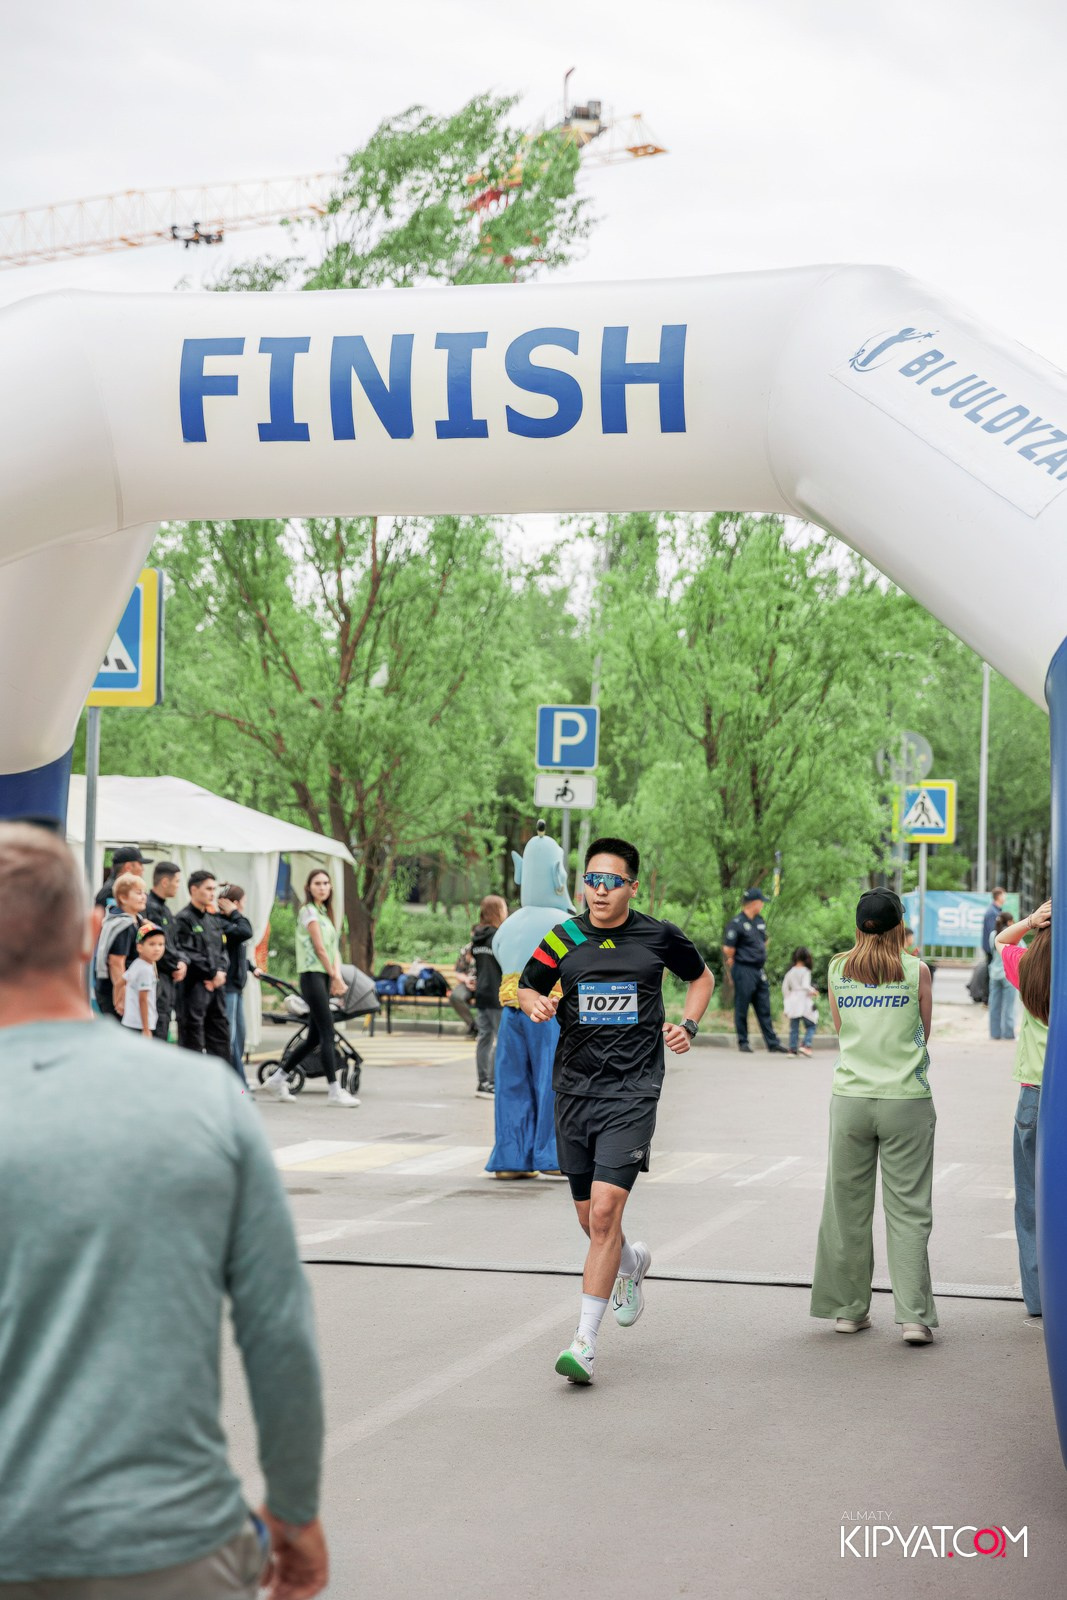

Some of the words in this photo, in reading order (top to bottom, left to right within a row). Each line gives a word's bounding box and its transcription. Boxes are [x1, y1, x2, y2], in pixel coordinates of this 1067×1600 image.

[179, 324, 688, 443] FINISH
[898, 348, 957, 386] BI
[930, 373, 1067, 482] JULDYZA
[552, 711, 588, 764] P
[586, 995, 632, 1012] 1077
[837, 995, 910, 1009] ВОЛОНТЕР
